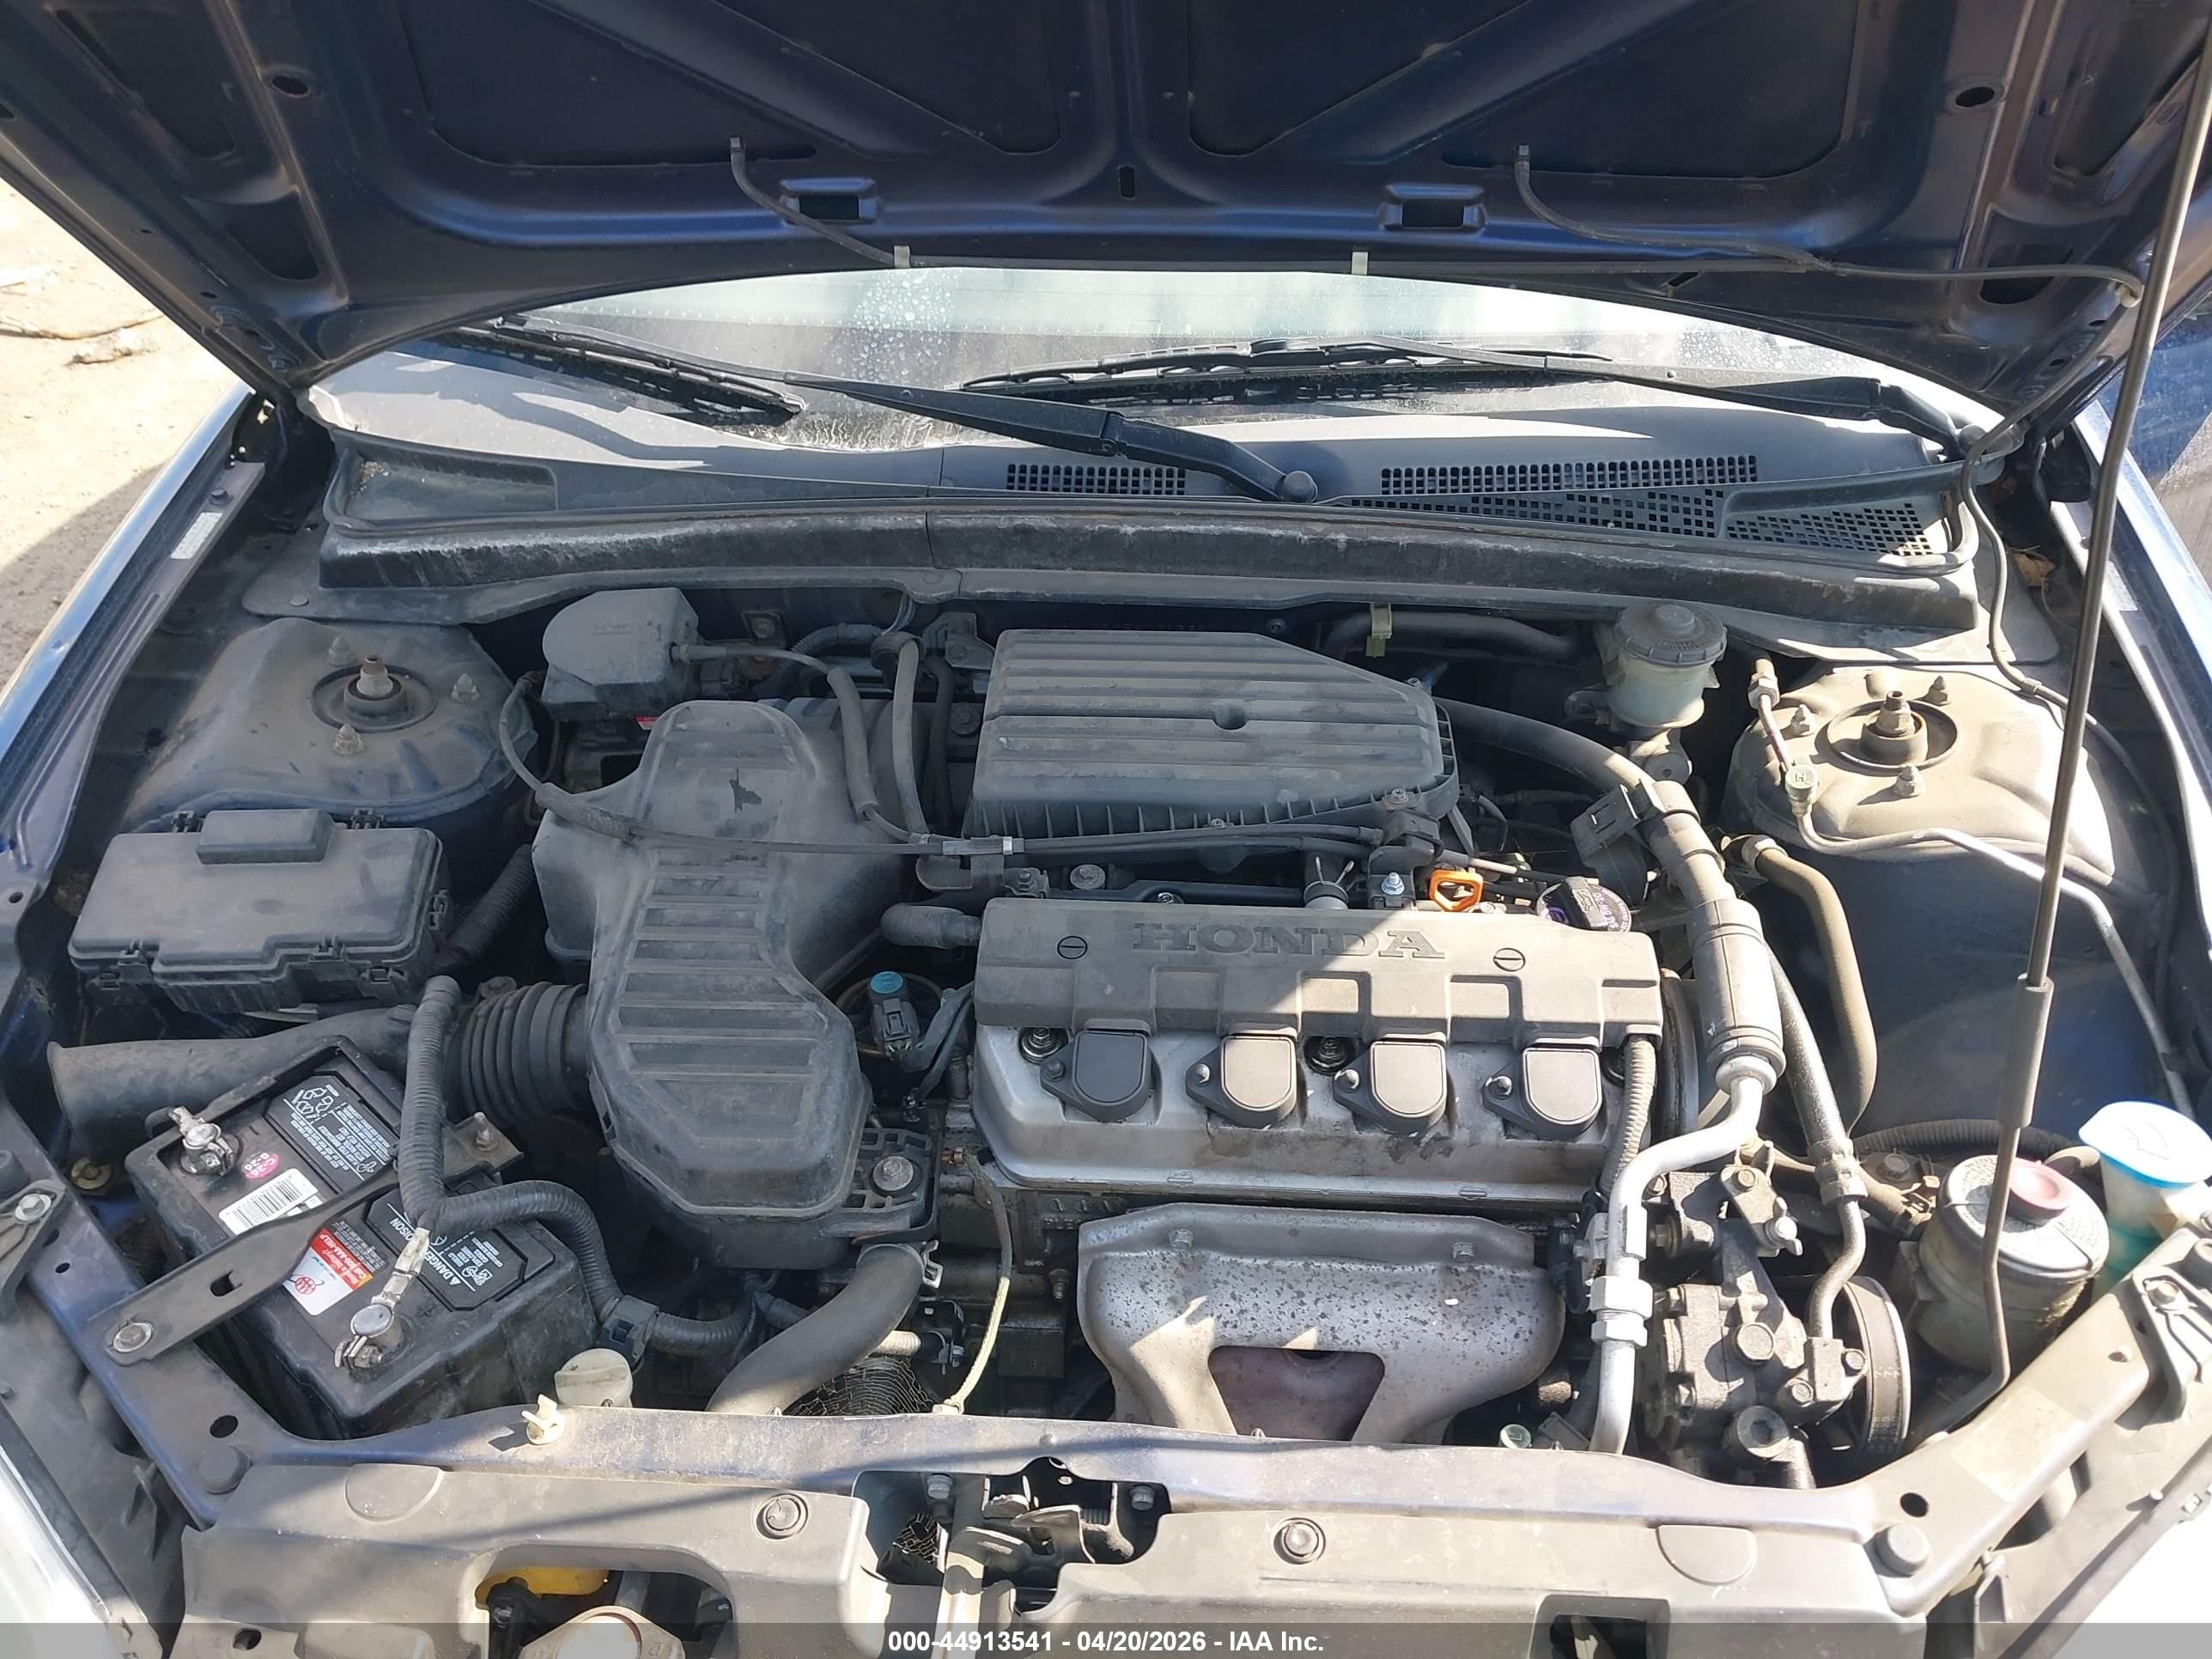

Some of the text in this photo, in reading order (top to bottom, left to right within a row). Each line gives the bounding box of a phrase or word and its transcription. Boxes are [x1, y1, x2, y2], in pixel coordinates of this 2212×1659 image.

[1133, 922, 1444, 958] HONDA
[390, 1218, 413, 1241] OISON
[424, 1250, 454, 1279] DANGE
